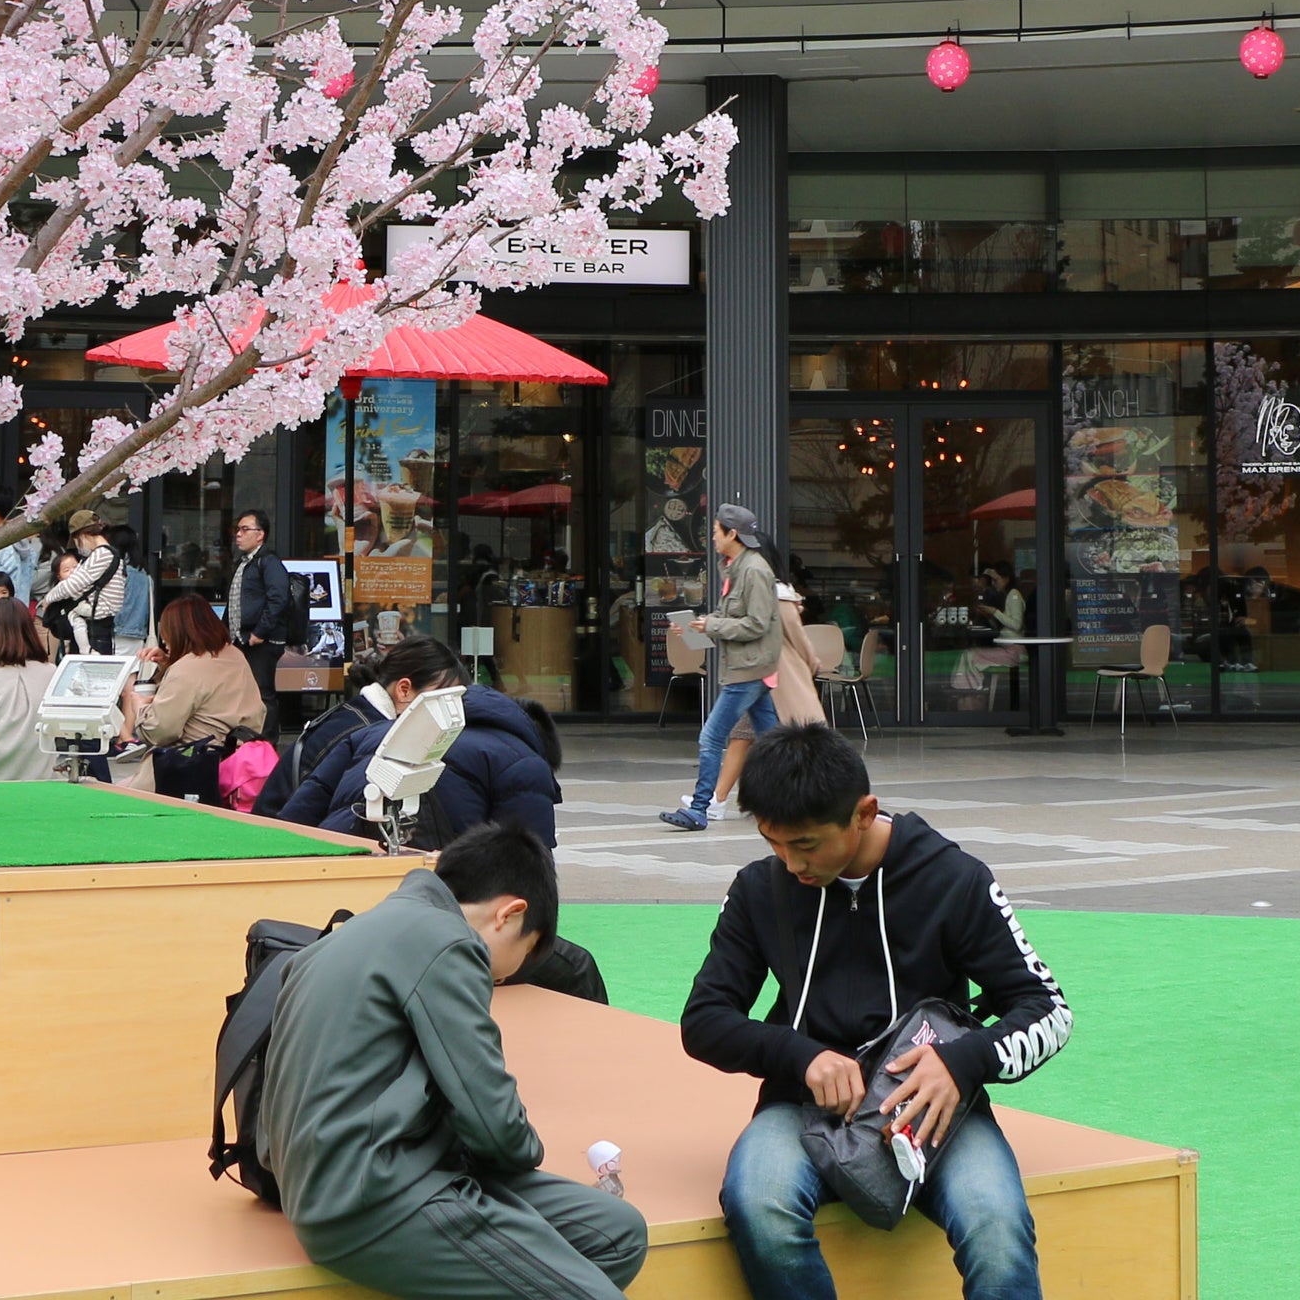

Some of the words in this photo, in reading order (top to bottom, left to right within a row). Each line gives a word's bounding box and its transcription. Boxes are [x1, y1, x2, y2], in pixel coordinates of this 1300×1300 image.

[508, 237, 649, 255] BREER
[583, 262, 625, 274] BAR
[355, 403, 414, 416] nniversary
[1071, 389, 1140, 419] LUNCH
[652, 409, 707, 438] DINNE
[1242, 466, 1267, 474] MAX
